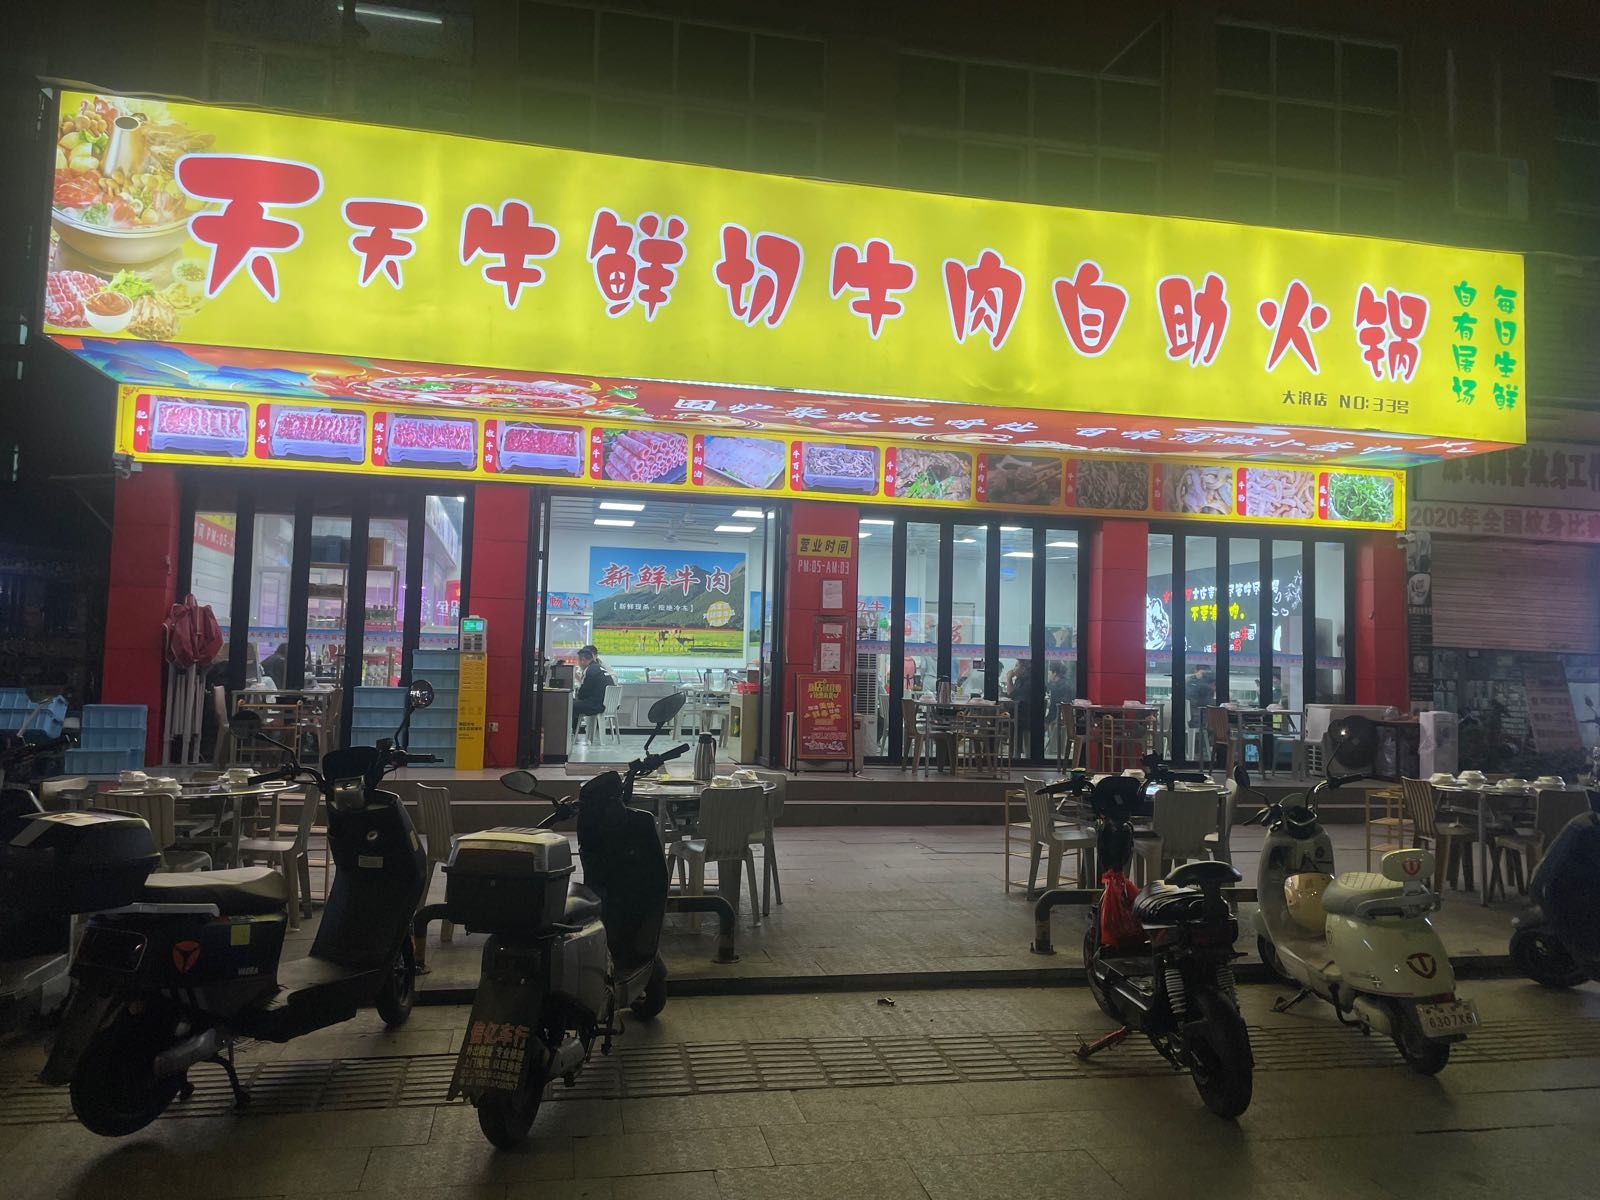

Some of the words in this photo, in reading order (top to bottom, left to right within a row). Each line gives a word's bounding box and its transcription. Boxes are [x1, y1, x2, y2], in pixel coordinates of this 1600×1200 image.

[173, 151, 1431, 386] 天天牛鲜切牛肉自助火锅
[1452, 280, 1478, 406] 自有屠场
[1493, 284, 1519, 410] 每日生鲜
[1282, 390, 1328, 407] 大浪店
[135, 410, 149, 437] 肥牛
[800, 537, 849, 554] 营业时间
[599, 562, 732, 597] 新鲜牛肉
[798, 559, 850, 575] PM:05-AM:03
